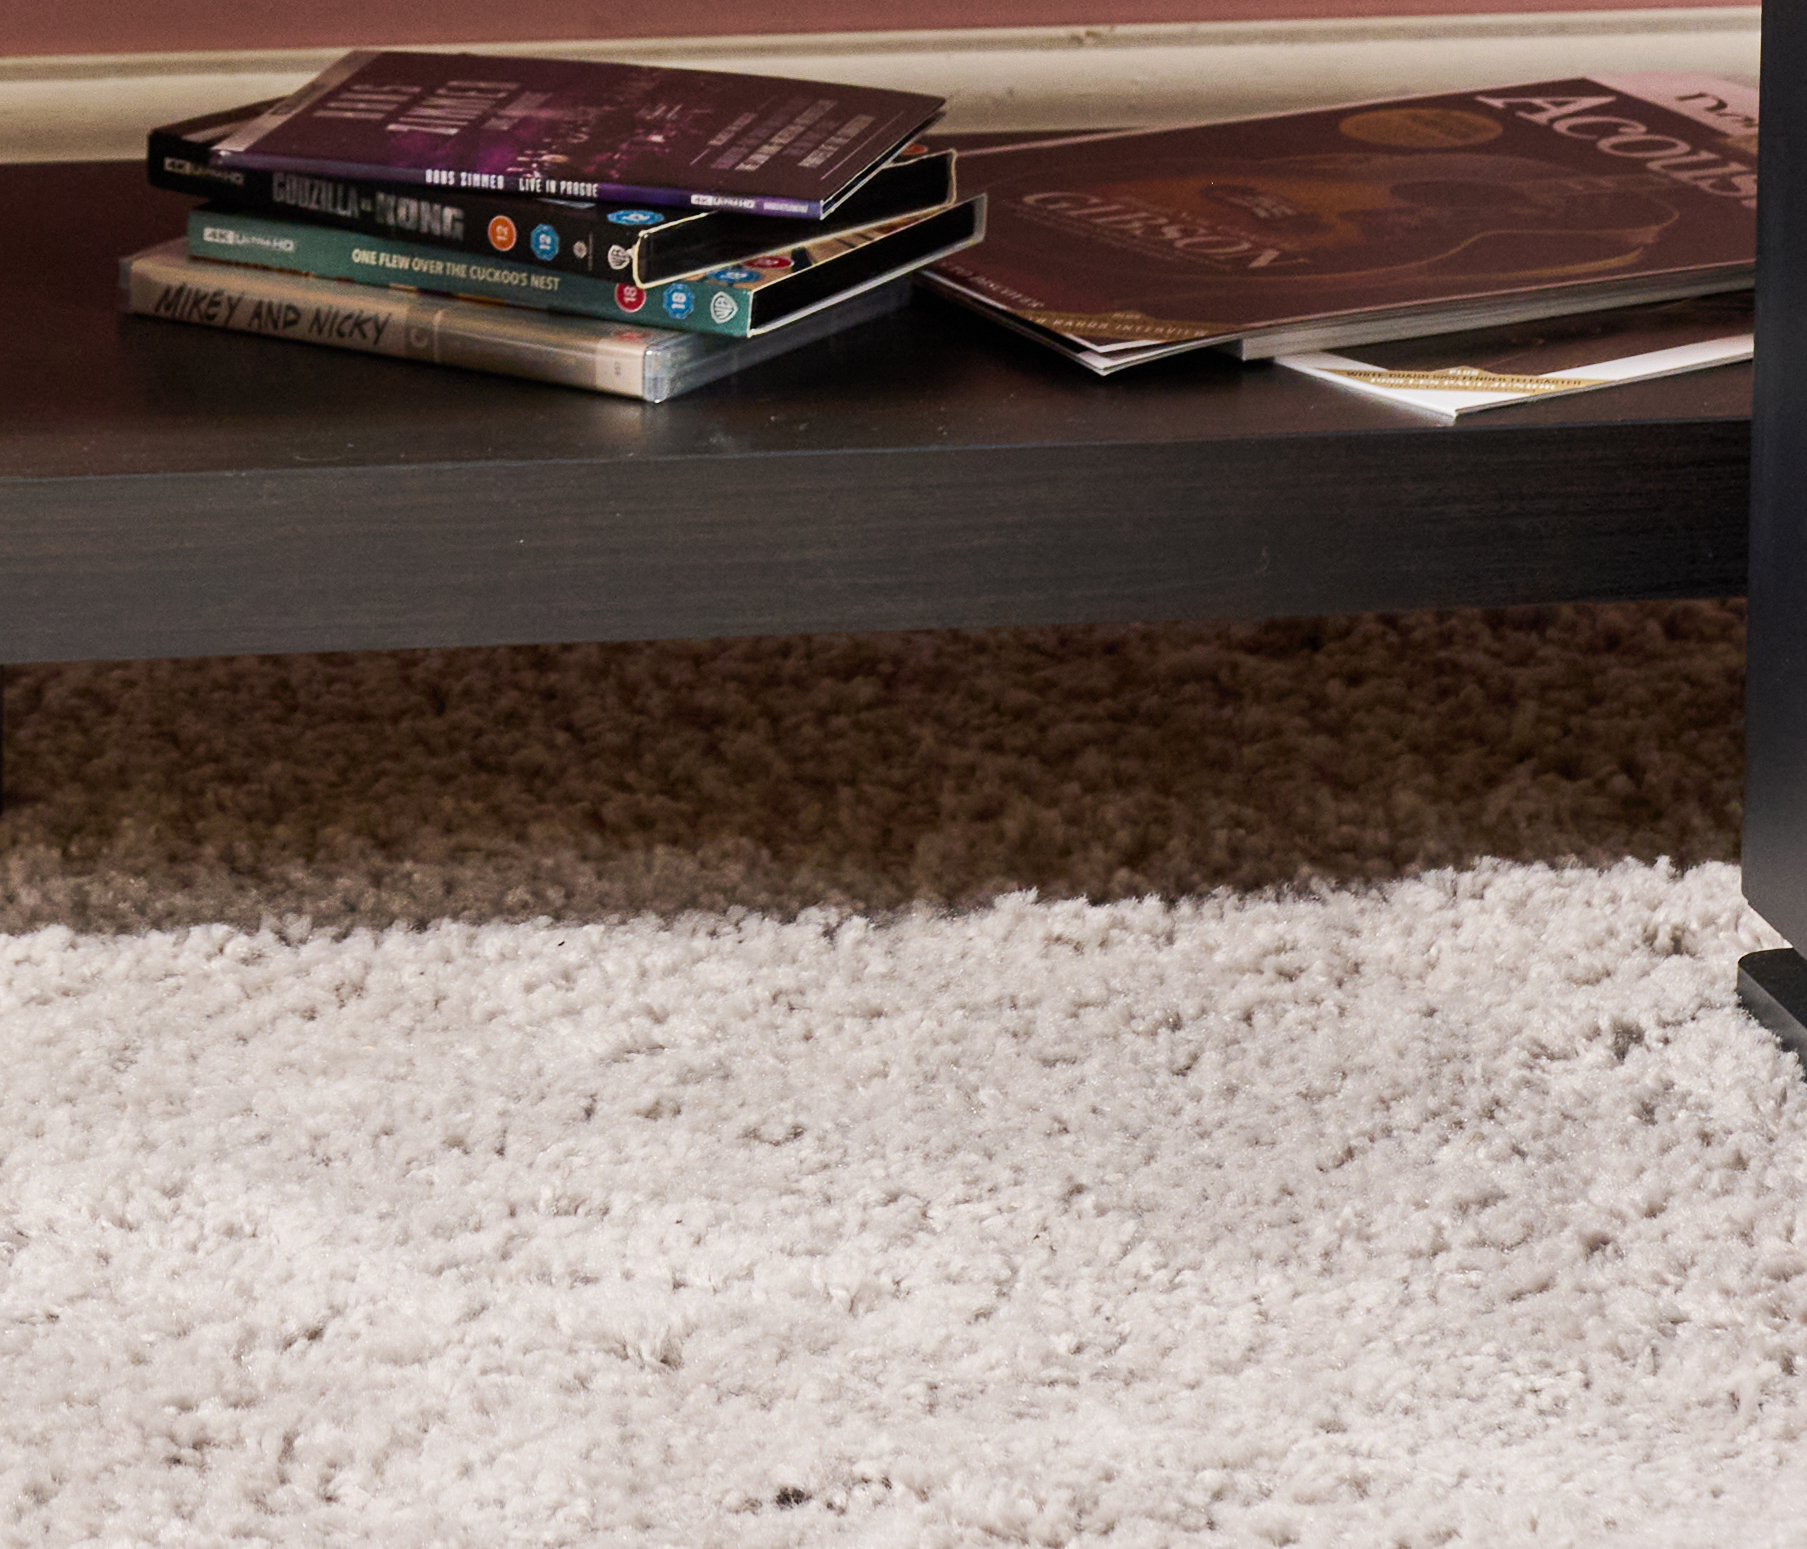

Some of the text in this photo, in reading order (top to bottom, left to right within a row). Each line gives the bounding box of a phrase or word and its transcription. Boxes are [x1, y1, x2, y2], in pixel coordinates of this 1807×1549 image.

[273, 172, 465, 241] GODZILLA KONG
[518, 177, 542, 193] LIVE
[545, 179, 557, 194] IN
[351, 248, 560, 291] ONE FLEW OVER THE CUCKOO'S NEST
[154, 282, 392, 346] MIKEY AND NICKY
[671, 292, 687, 309] 18
